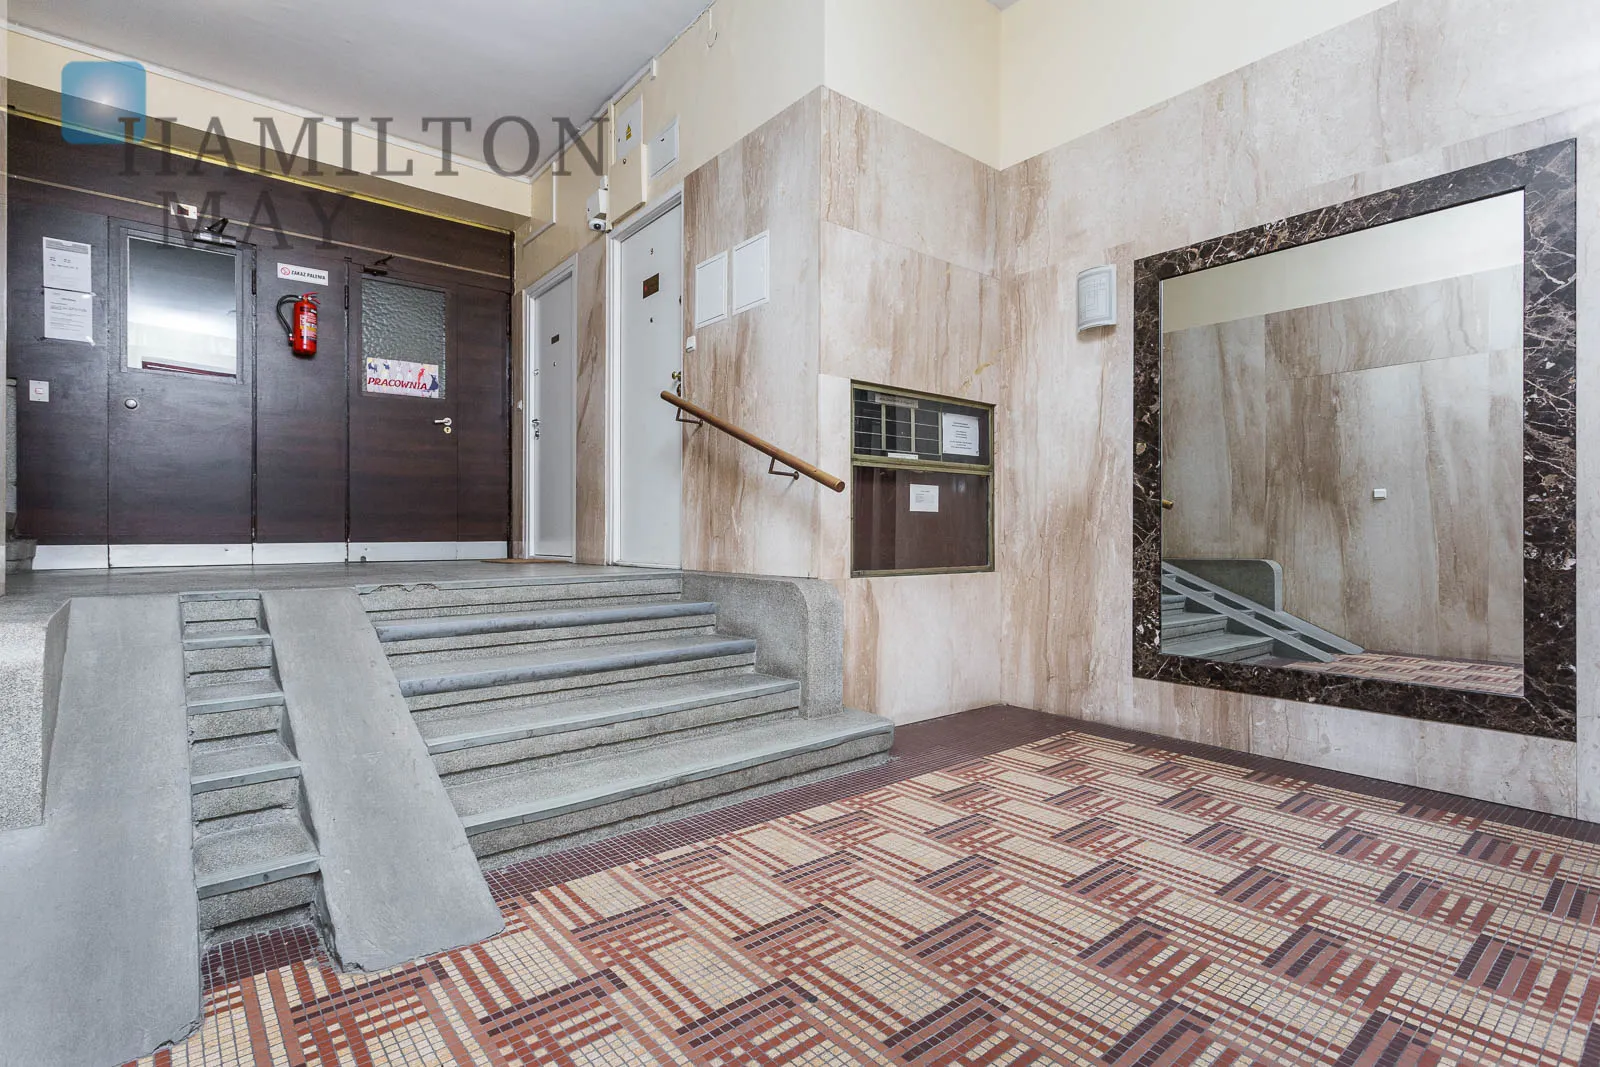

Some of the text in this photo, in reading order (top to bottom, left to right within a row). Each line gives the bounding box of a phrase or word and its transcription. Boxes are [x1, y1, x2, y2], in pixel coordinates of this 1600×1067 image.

[291, 270, 326, 280] ZAKAZ PALENIA
[367, 377, 428, 390] PRACOWNIA
